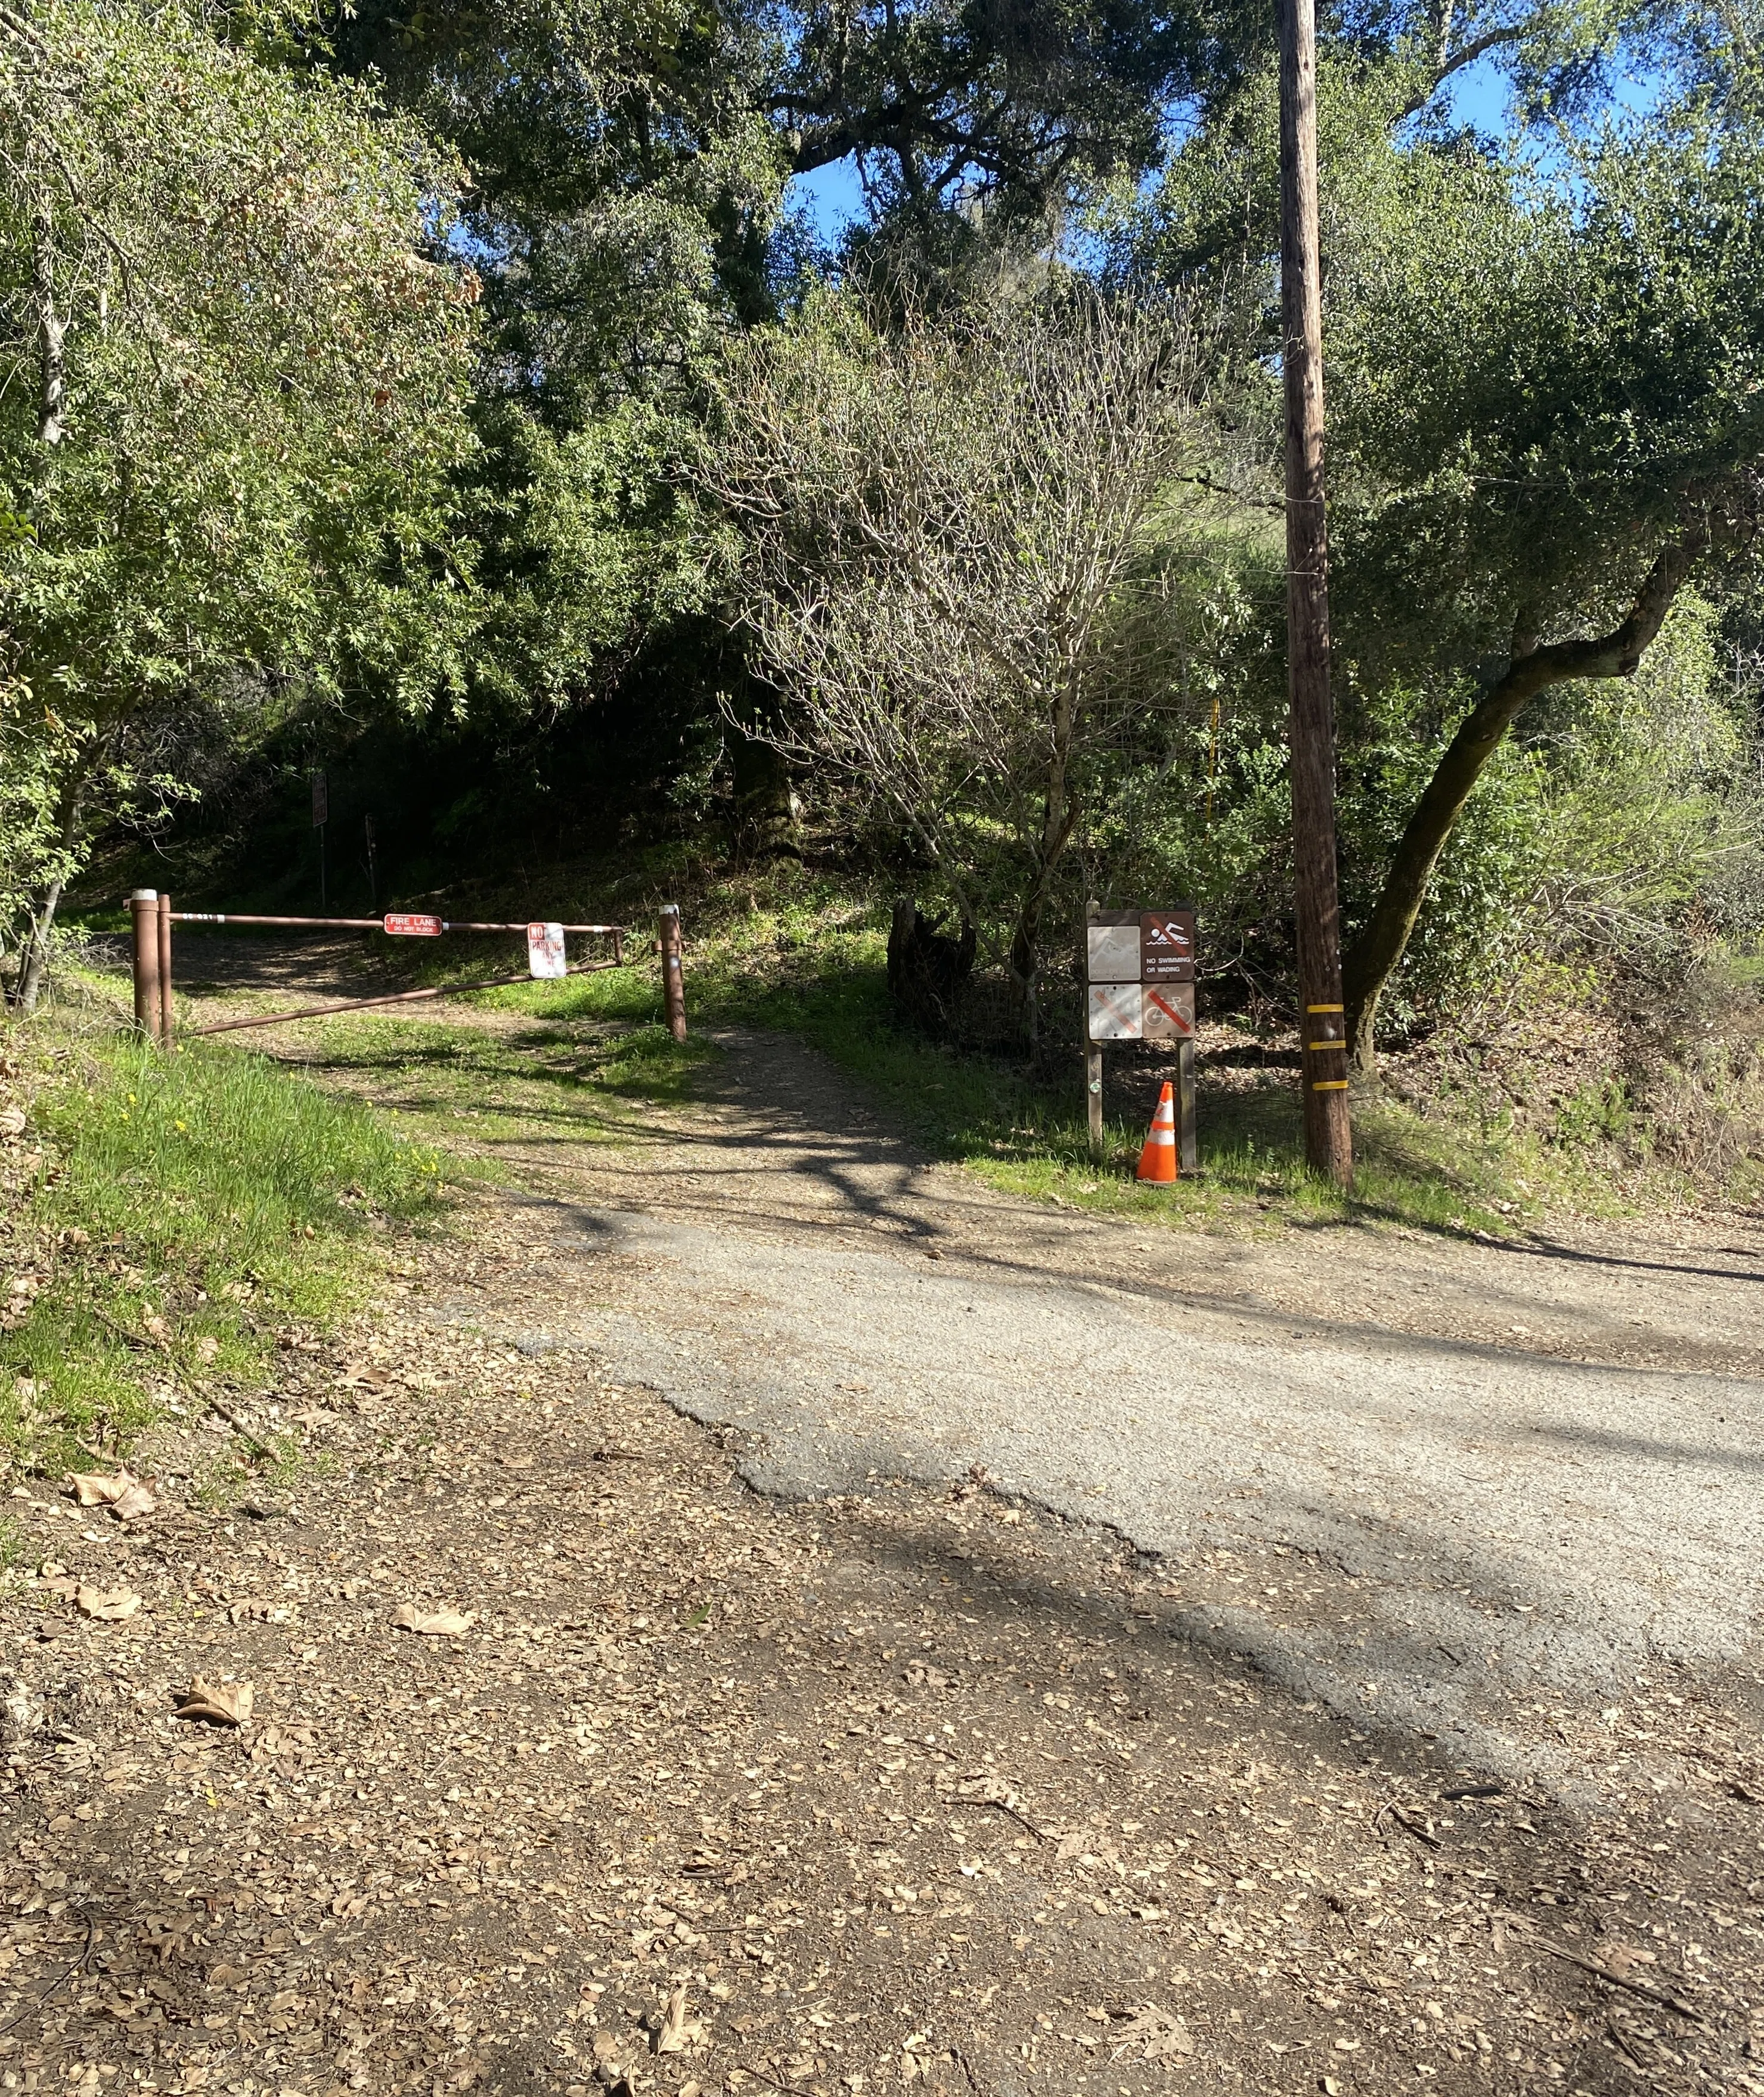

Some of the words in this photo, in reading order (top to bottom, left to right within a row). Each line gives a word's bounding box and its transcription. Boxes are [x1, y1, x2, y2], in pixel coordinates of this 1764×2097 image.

[390, 917, 410, 925] FIRE
[414, 918, 436, 926] LANE
[531, 926, 543, 938] NO
[532, 941, 562, 951] PARKING
[542, 951, 554, 960] ANY
